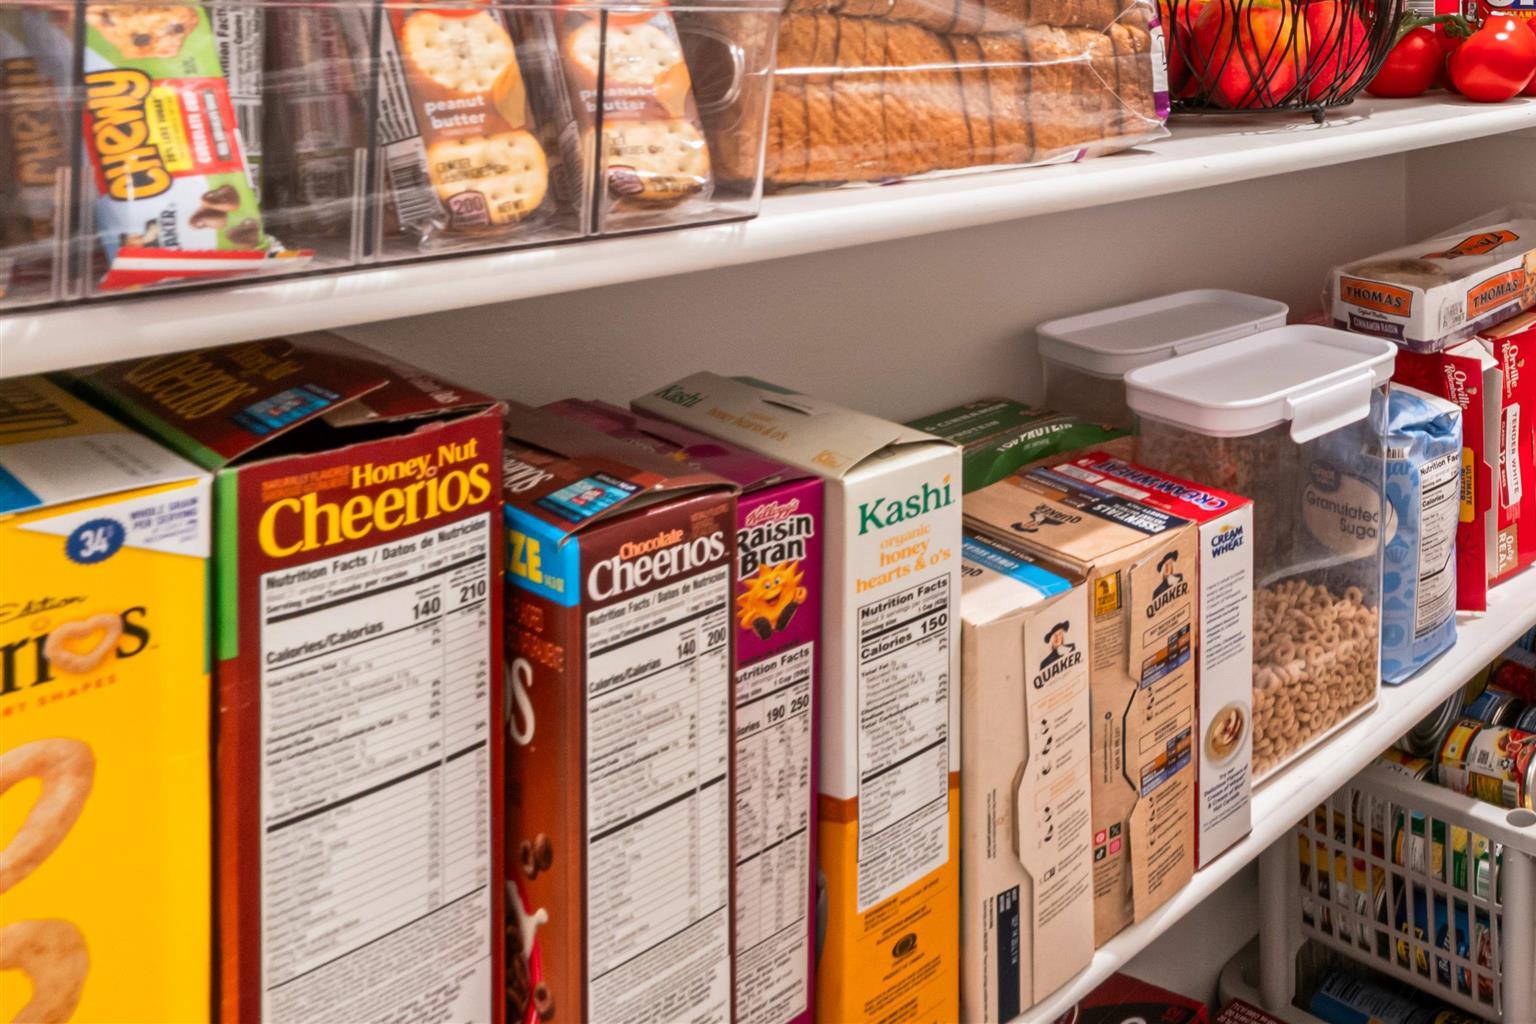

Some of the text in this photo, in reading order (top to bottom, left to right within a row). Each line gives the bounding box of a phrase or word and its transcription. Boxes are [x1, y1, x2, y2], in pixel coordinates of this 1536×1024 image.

[424, 96, 485, 115] peanut
[431, 111, 485, 130] butter
[1509, 344, 1520, 388] Orville
[1454, 366, 1468, 410] Orville
[351, 437, 479, 489] Honey Nut
[1420, 459, 1446, 475] Nutrition
[1510, 411, 1520, 493] TENDER WHITE
[258, 463, 492, 558] Cheerios
[745, 498, 800, 526] Kellogg's
[858, 476, 953, 535] Kashi
[1422, 494, 1445, 507] Calories
[619, 528, 683, 560] Chocolate
[736, 516, 812, 553] Raisin
[880, 524, 930, 550] organic
[1211, 526, 1244, 547] CREAM
[1340, 517, 1376, 540] Suga
[266, 567, 328, 590] Nutrition
[332, 557, 368, 575] Facts
[382, 543, 417, 561] Datos
[420, 537, 433, 549] de
[740, 539, 803, 578] Bran
[879, 538, 930, 568] honey
[1211, 538, 1245, 559] WHEAT
[1498, 533, 1506, 572] REAL
[588, 530, 725, 601] Cheerios
[856, 564, 911, 594] hearts
[915, 557, 926, 570] &
[460, 580, 487, 604] 210
[861, 578, 948, 619] Nutrition Facts
[1146, 581, 1188, 619] QUAKER
[413, 597, 441, 620] 140
[920, 613, 948, 634] 150
[677, 639, 696, 659] 140
[708, 627, 726, 647] 200
[861, 632, 913, 659] Calories
[736, 648, 810, 685] utrition Facts
[1033, 651, 1082, 690] QUAKER
[767, 695, 809, 723] 190 250
